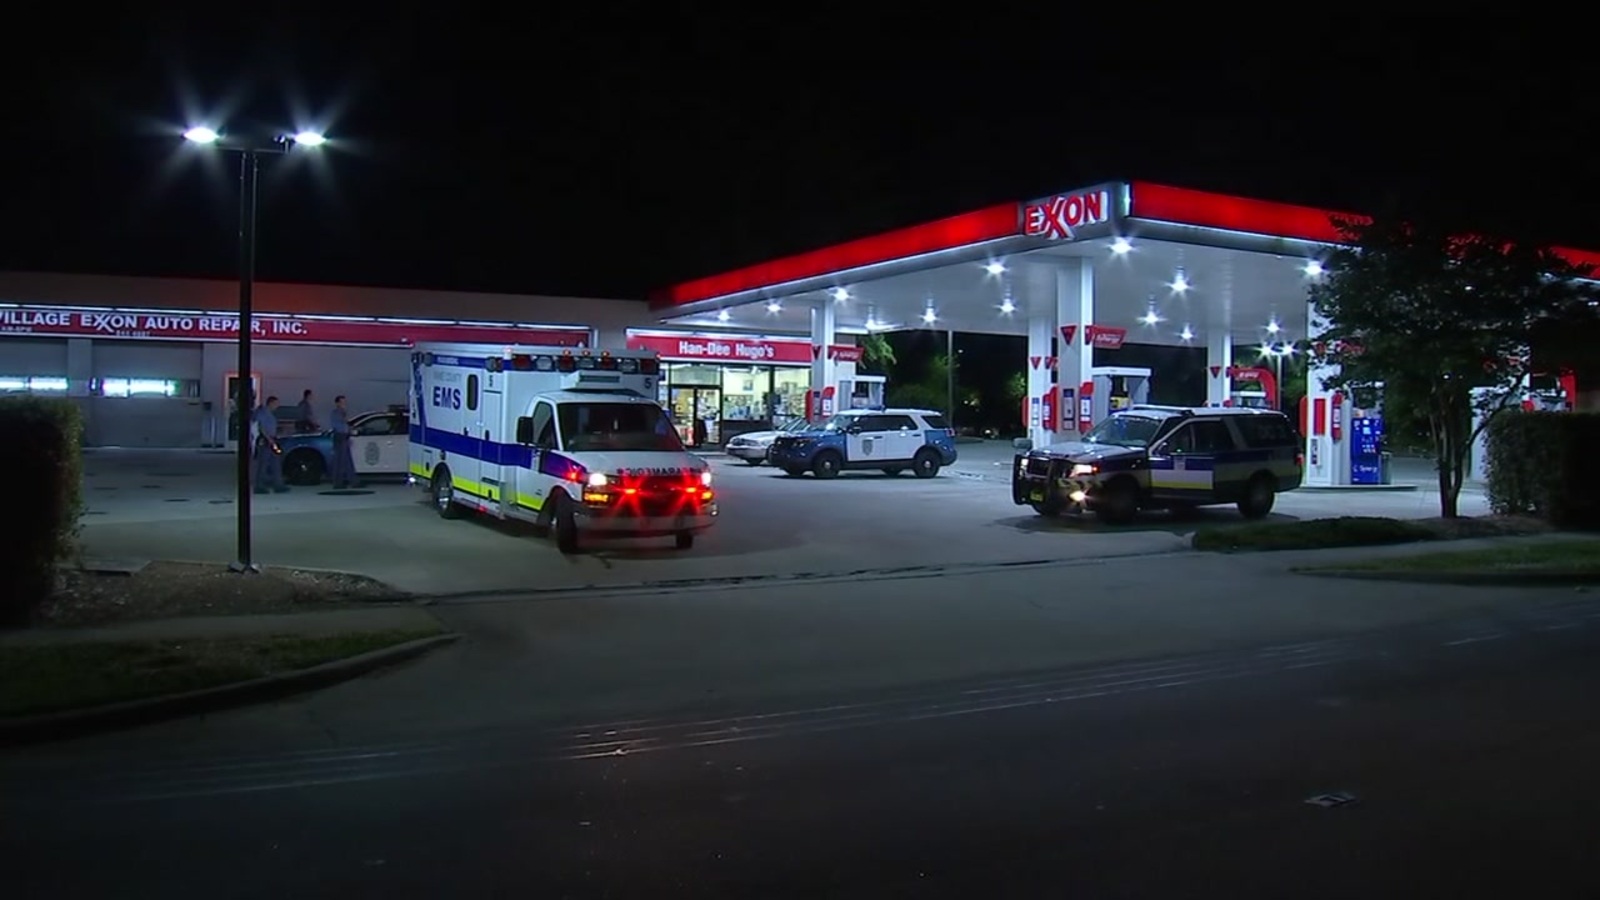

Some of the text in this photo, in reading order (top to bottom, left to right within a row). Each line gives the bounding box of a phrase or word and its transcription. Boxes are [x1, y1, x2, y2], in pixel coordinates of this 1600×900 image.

[1024, 190, 1108, 240] EXXON
[80, 313, 137, 333] EXXON
[145, 316, 193, 330] AUTO
[199, 318, 266, 336] REPAR,
[272, 321, 308, 335] INC.
[679, 340, 774, 360] Han-Dee Hugo's
[644, 377, 652, 389] 5
[433, 385, 461, 411] EMS
